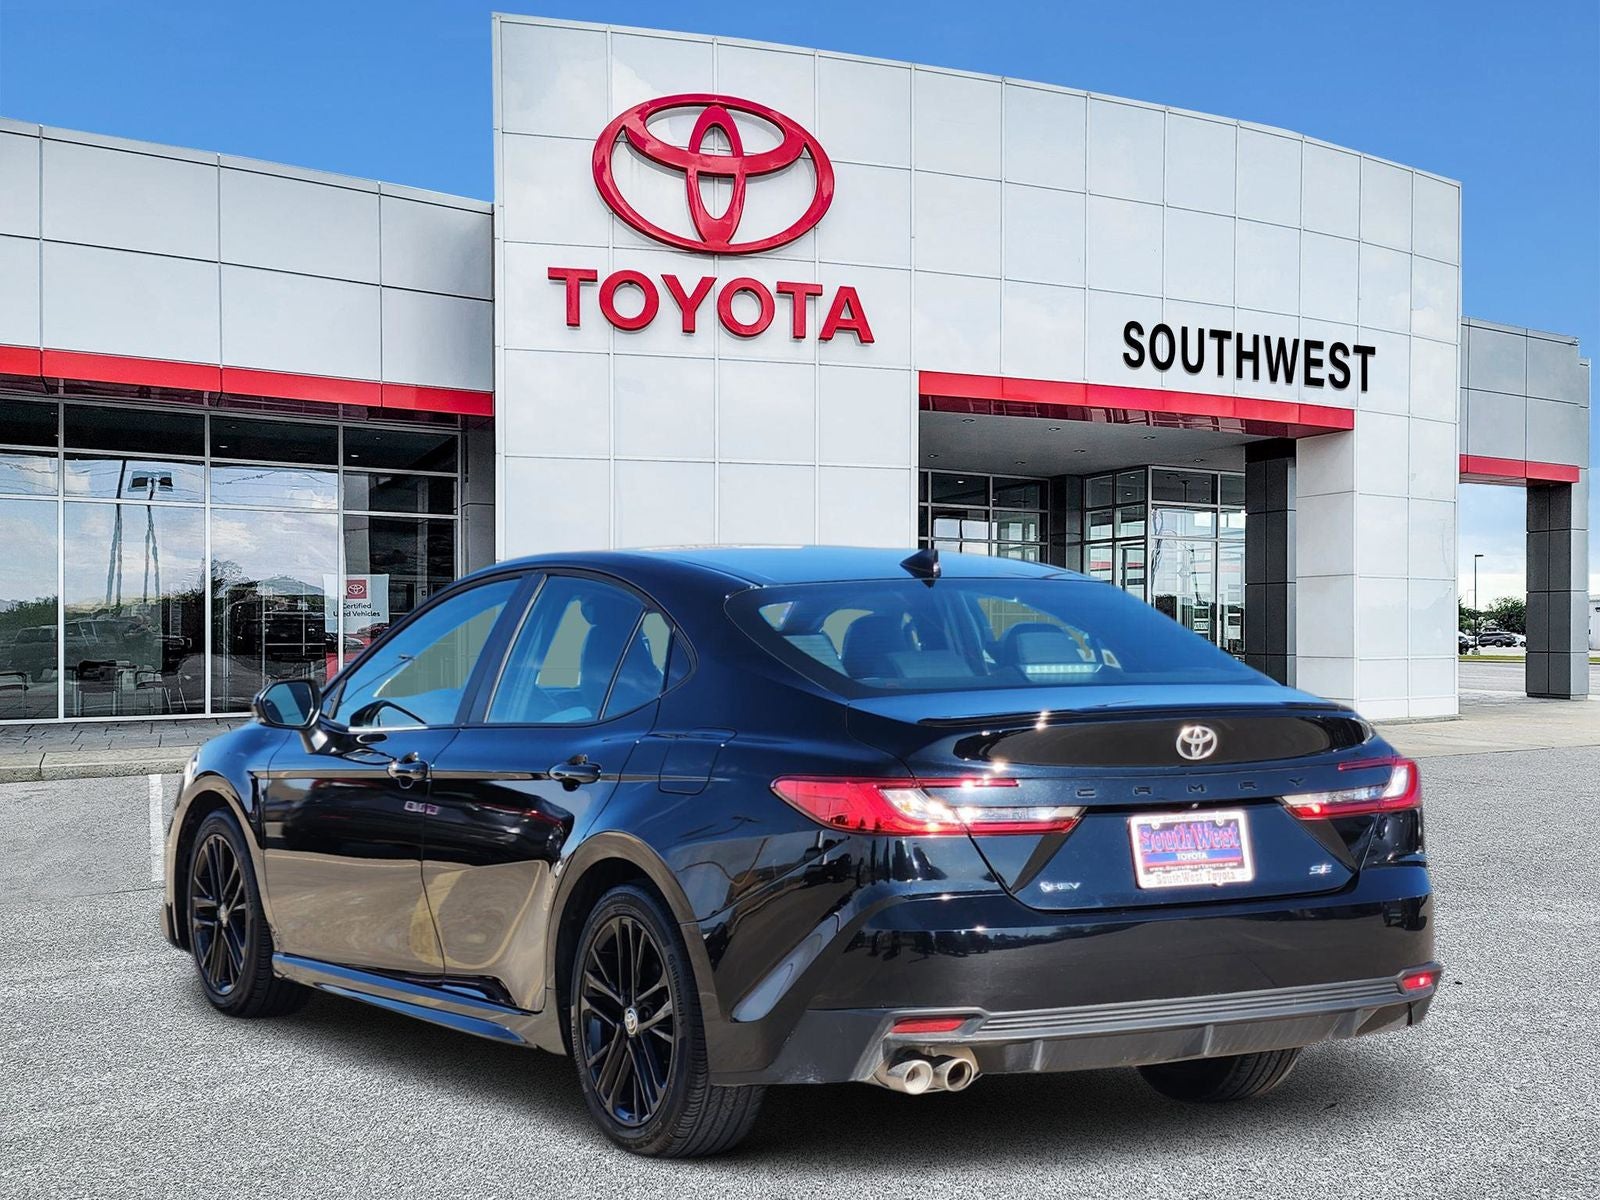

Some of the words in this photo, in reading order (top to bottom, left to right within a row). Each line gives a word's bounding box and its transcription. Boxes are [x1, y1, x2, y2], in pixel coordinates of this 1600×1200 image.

[548, 267, 875, 344] TOYOTA
[1123, 320, 1376, 393] SOUTHWEST
[1076, 777, 1304, 797] CAMRY
[1176, 851, 1208, 861] TOYOTA
[1309, 864, 1332, 875] SE
